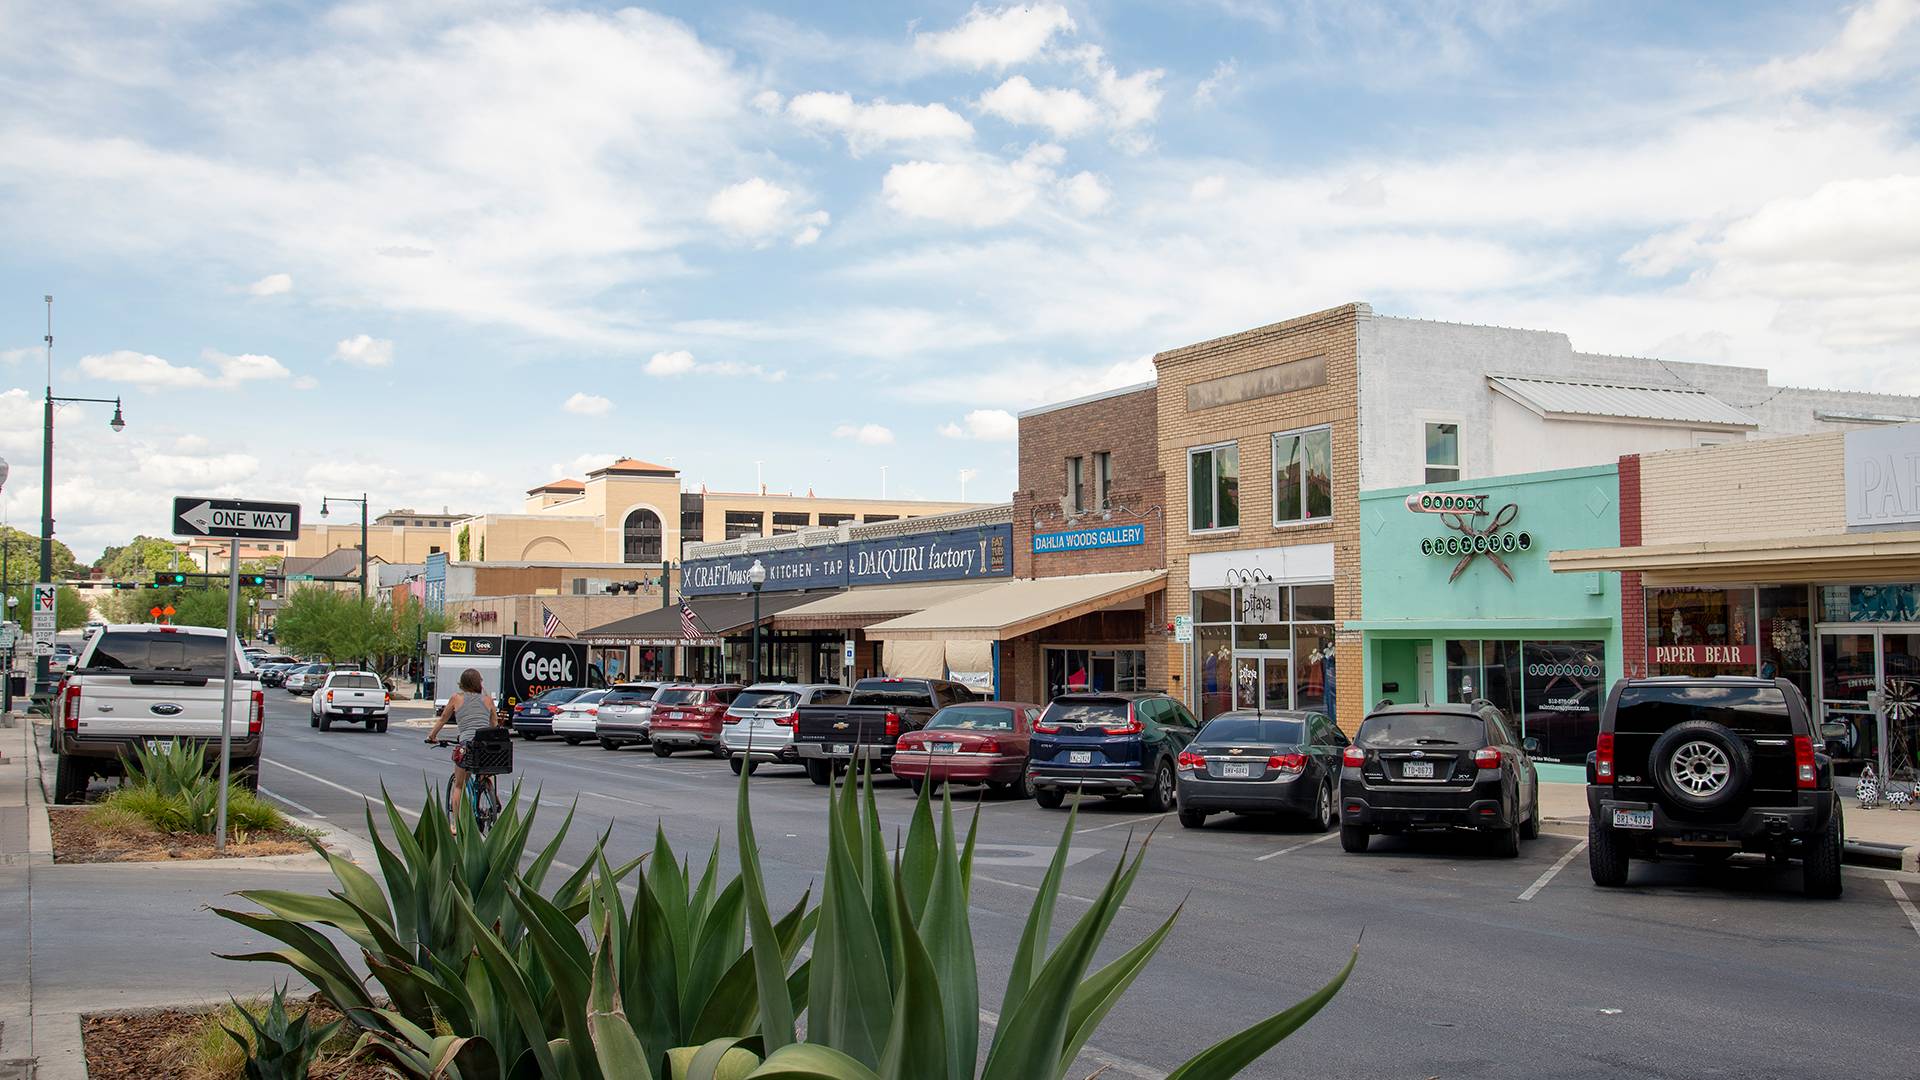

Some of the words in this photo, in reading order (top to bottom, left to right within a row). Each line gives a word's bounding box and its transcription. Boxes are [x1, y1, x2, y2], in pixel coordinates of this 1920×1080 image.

[1423, 497, 1475, 508] Salon
[213, 511, 246, 527] ONE
[252, 513, 287, 529] WAY
[991, 537, 1004, 547] FAT
[1035, 535, 1065, 550] DAHLIA
[1066, 532, 1098, 547] WOODS
[1099, 528, 1141, 545] GALLERY
[769, 563, 812, 580] KITCHEN
[823, 559, 843, 575] TAP
[848, 560, 856, 573] &
[858, 546, 924, 579] DAIQUIRI
[928, 543, 976, 575] factory
[991, 556, 1004, 565] DAY
[1243, 587, 1272, 624] pitaya
[1656, 646, 1696, 663] PAPER
[1705, 646, 1741, 663] BEAR
[521, 651, 573, 681] Geek
